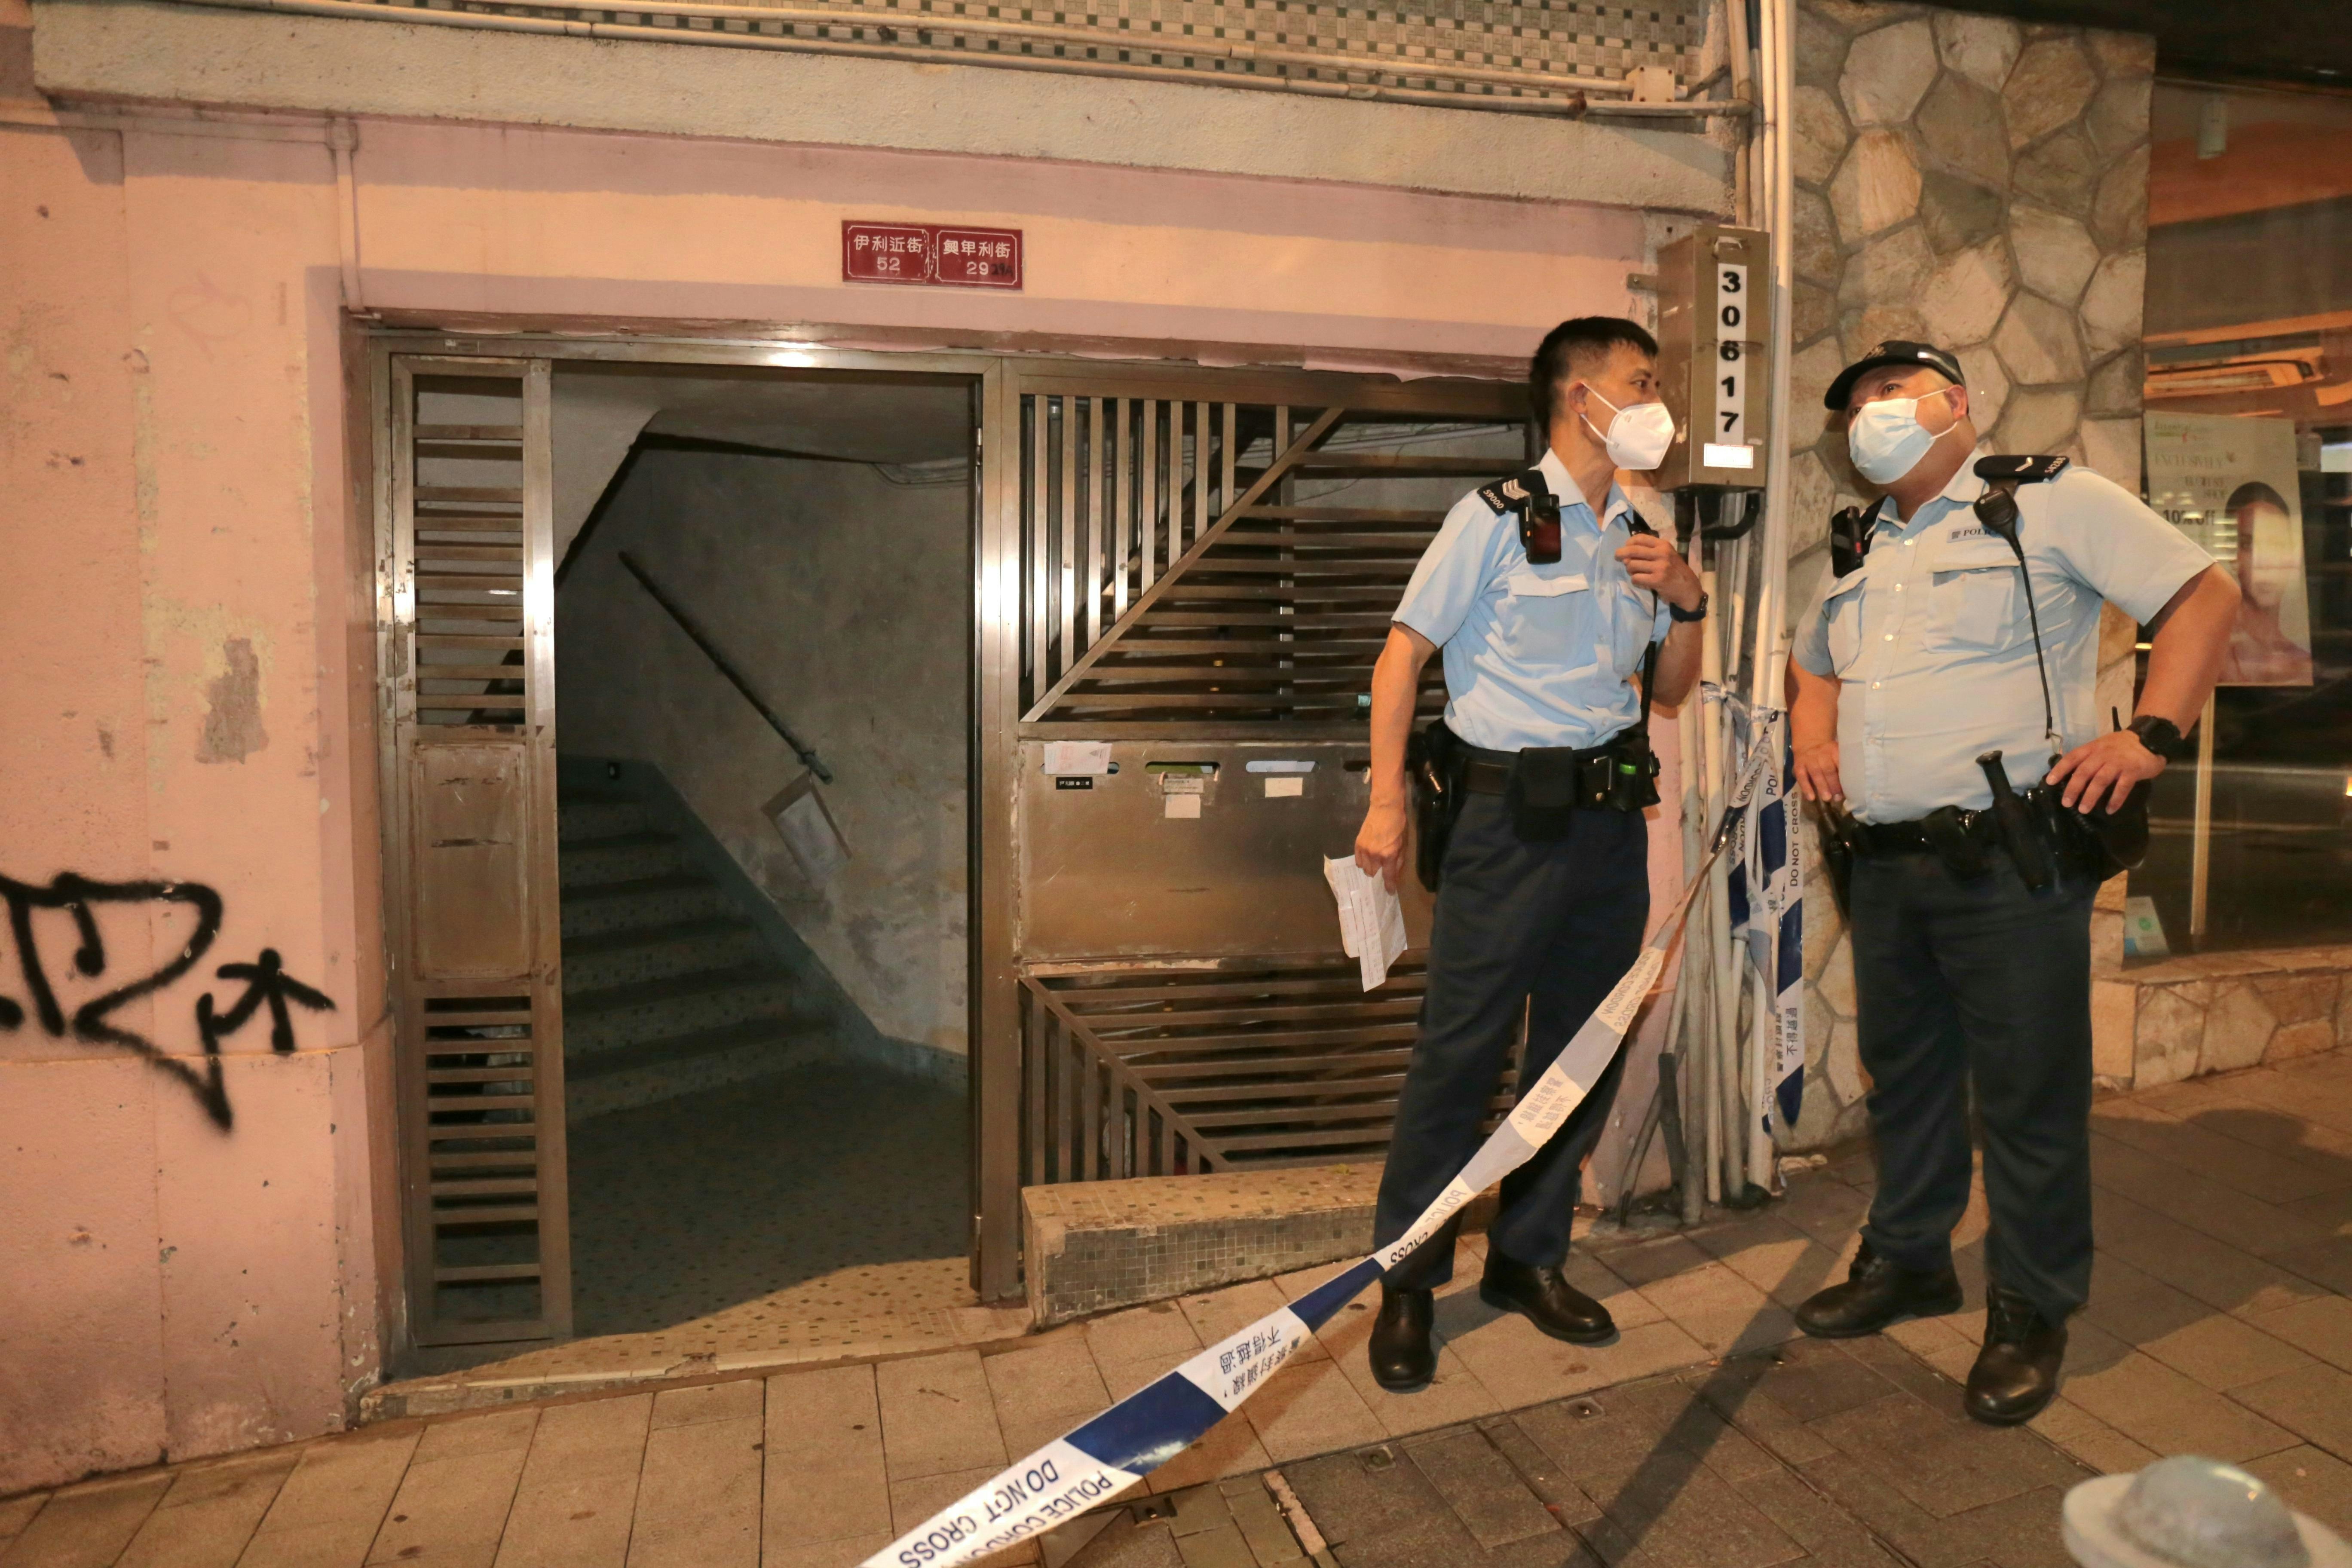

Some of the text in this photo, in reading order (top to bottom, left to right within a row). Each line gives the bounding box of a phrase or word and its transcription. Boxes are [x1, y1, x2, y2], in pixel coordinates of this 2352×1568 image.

[853, 234, 923, 254] 伊利近街
[943, 239, 1011, 258] 奧卑利街
[876, 257, 900, 271] 52
[966, 262, 989, 276] 29
[1719, 271, 1741, 433] 30617
[1790, 841, 1799, 866] NOT
[1790, 868, 1798, 887] DO
[1785, 1008, 1798, 1056] 不得越過
[1219, 1325, 1281, 1374] 不得越過
[1039, 1470, 1113, 1519] POLICE
[899, 1458, 1059, 1568] DO NOT CROSS
